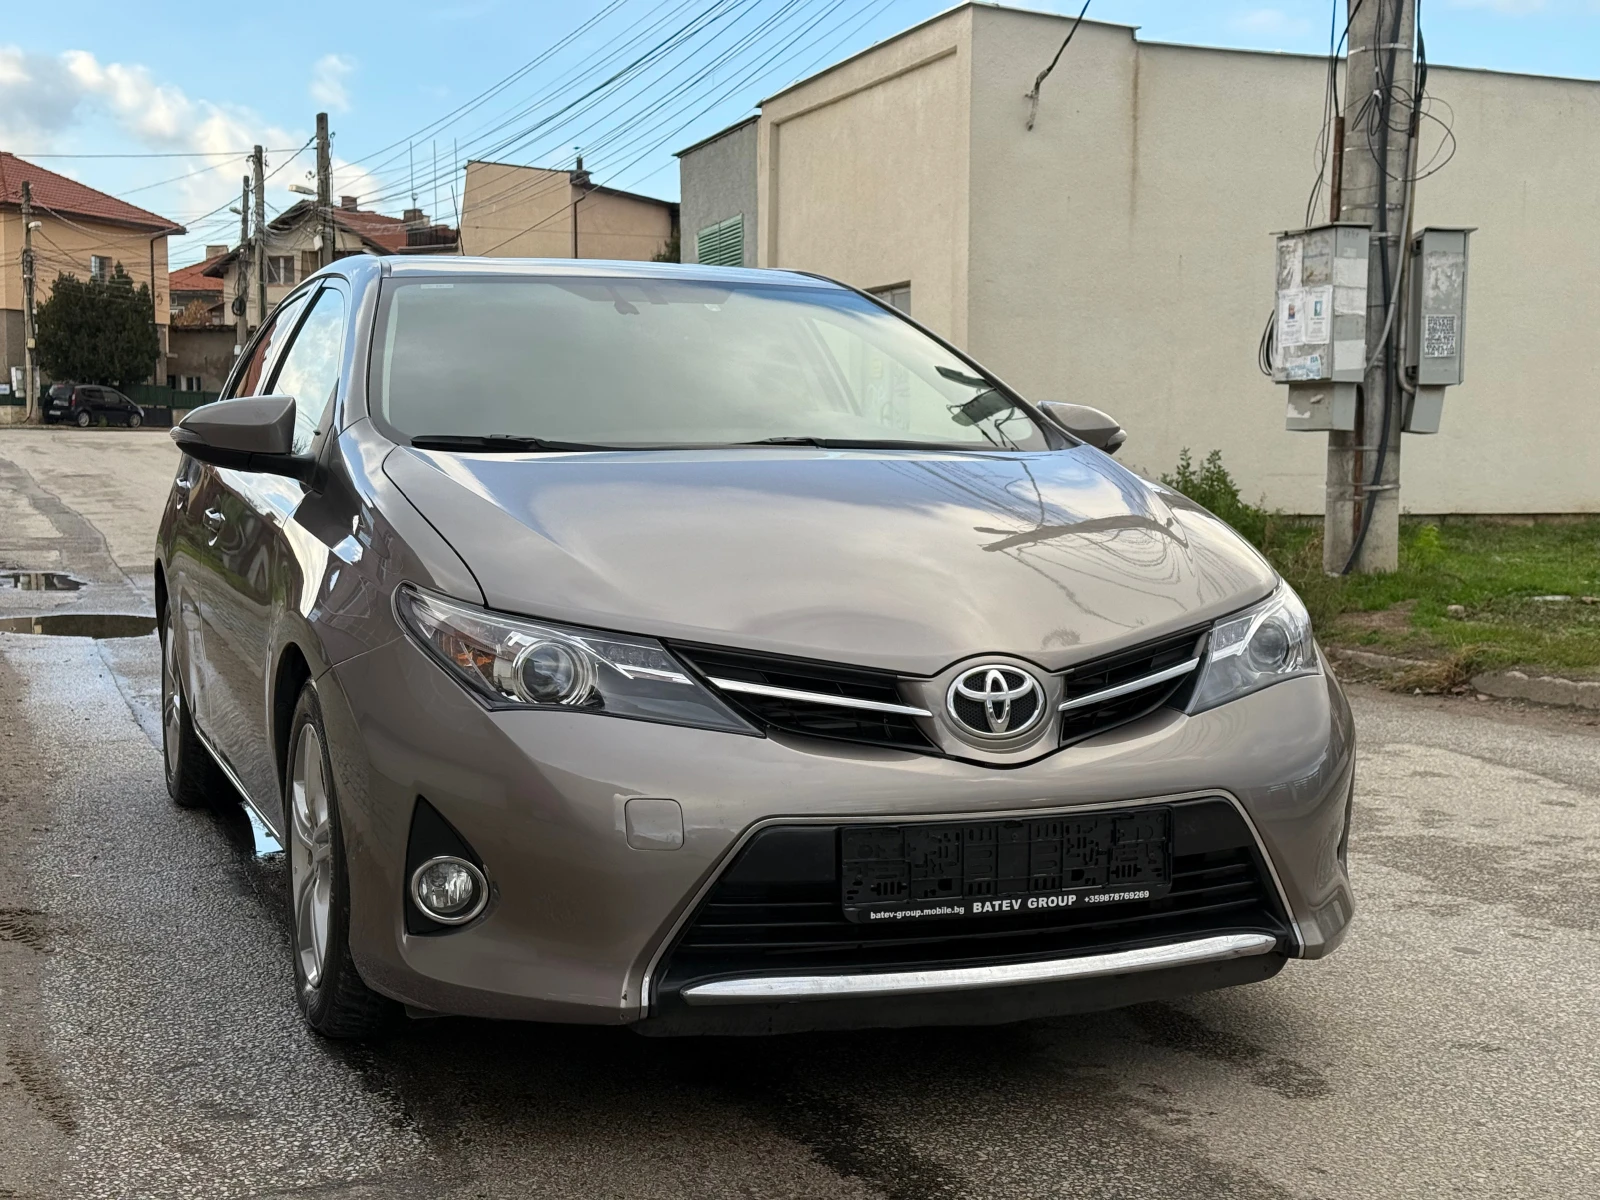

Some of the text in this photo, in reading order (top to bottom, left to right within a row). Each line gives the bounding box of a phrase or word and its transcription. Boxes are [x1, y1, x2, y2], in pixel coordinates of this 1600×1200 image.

[870, 890, 1150, 919] batev-group.mobile.bg BATEV GROUP +359878769269
